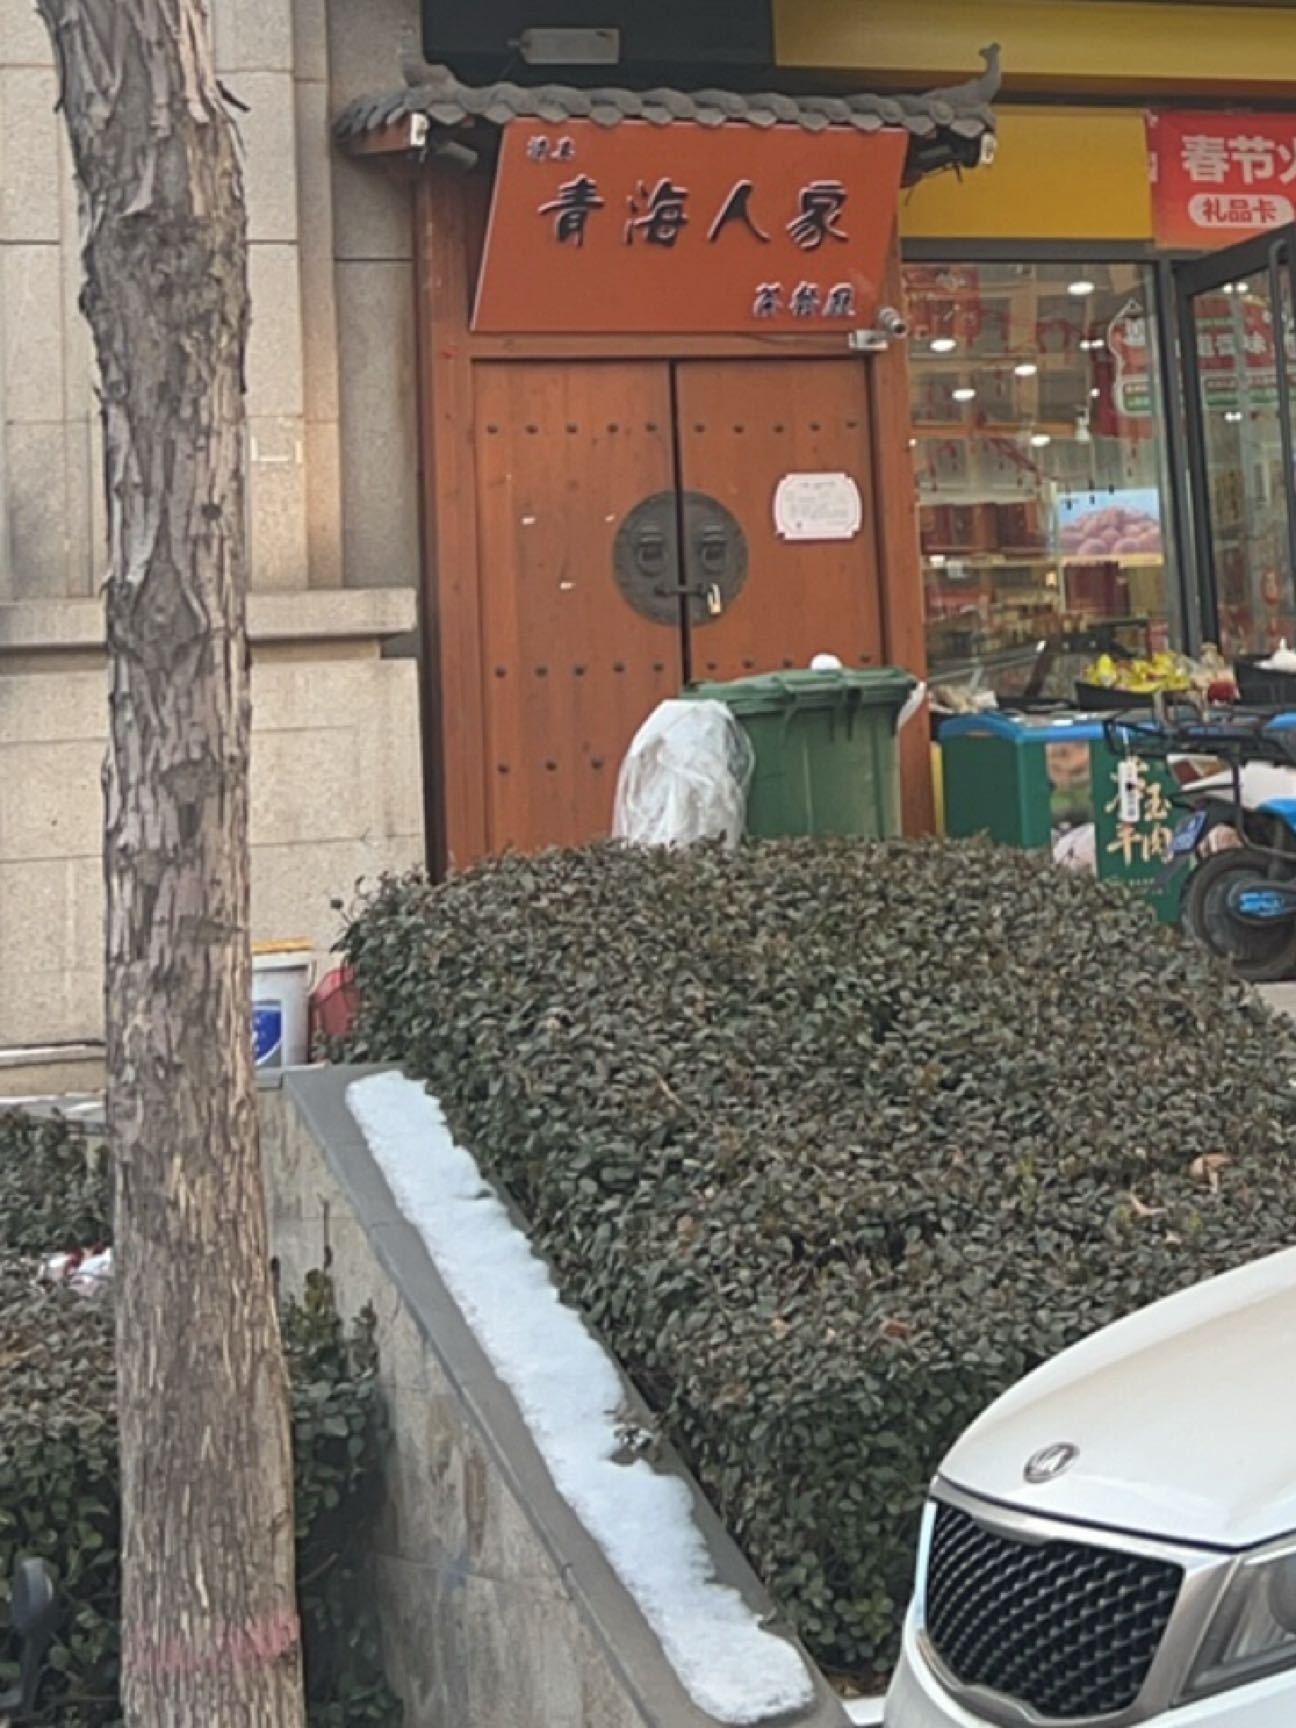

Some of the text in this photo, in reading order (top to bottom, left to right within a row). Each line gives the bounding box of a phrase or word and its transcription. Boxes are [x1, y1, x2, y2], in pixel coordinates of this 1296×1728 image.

[539, 173, 851, 251] 青海人家
[1202, 199, 1277, 223] 礼品卡
